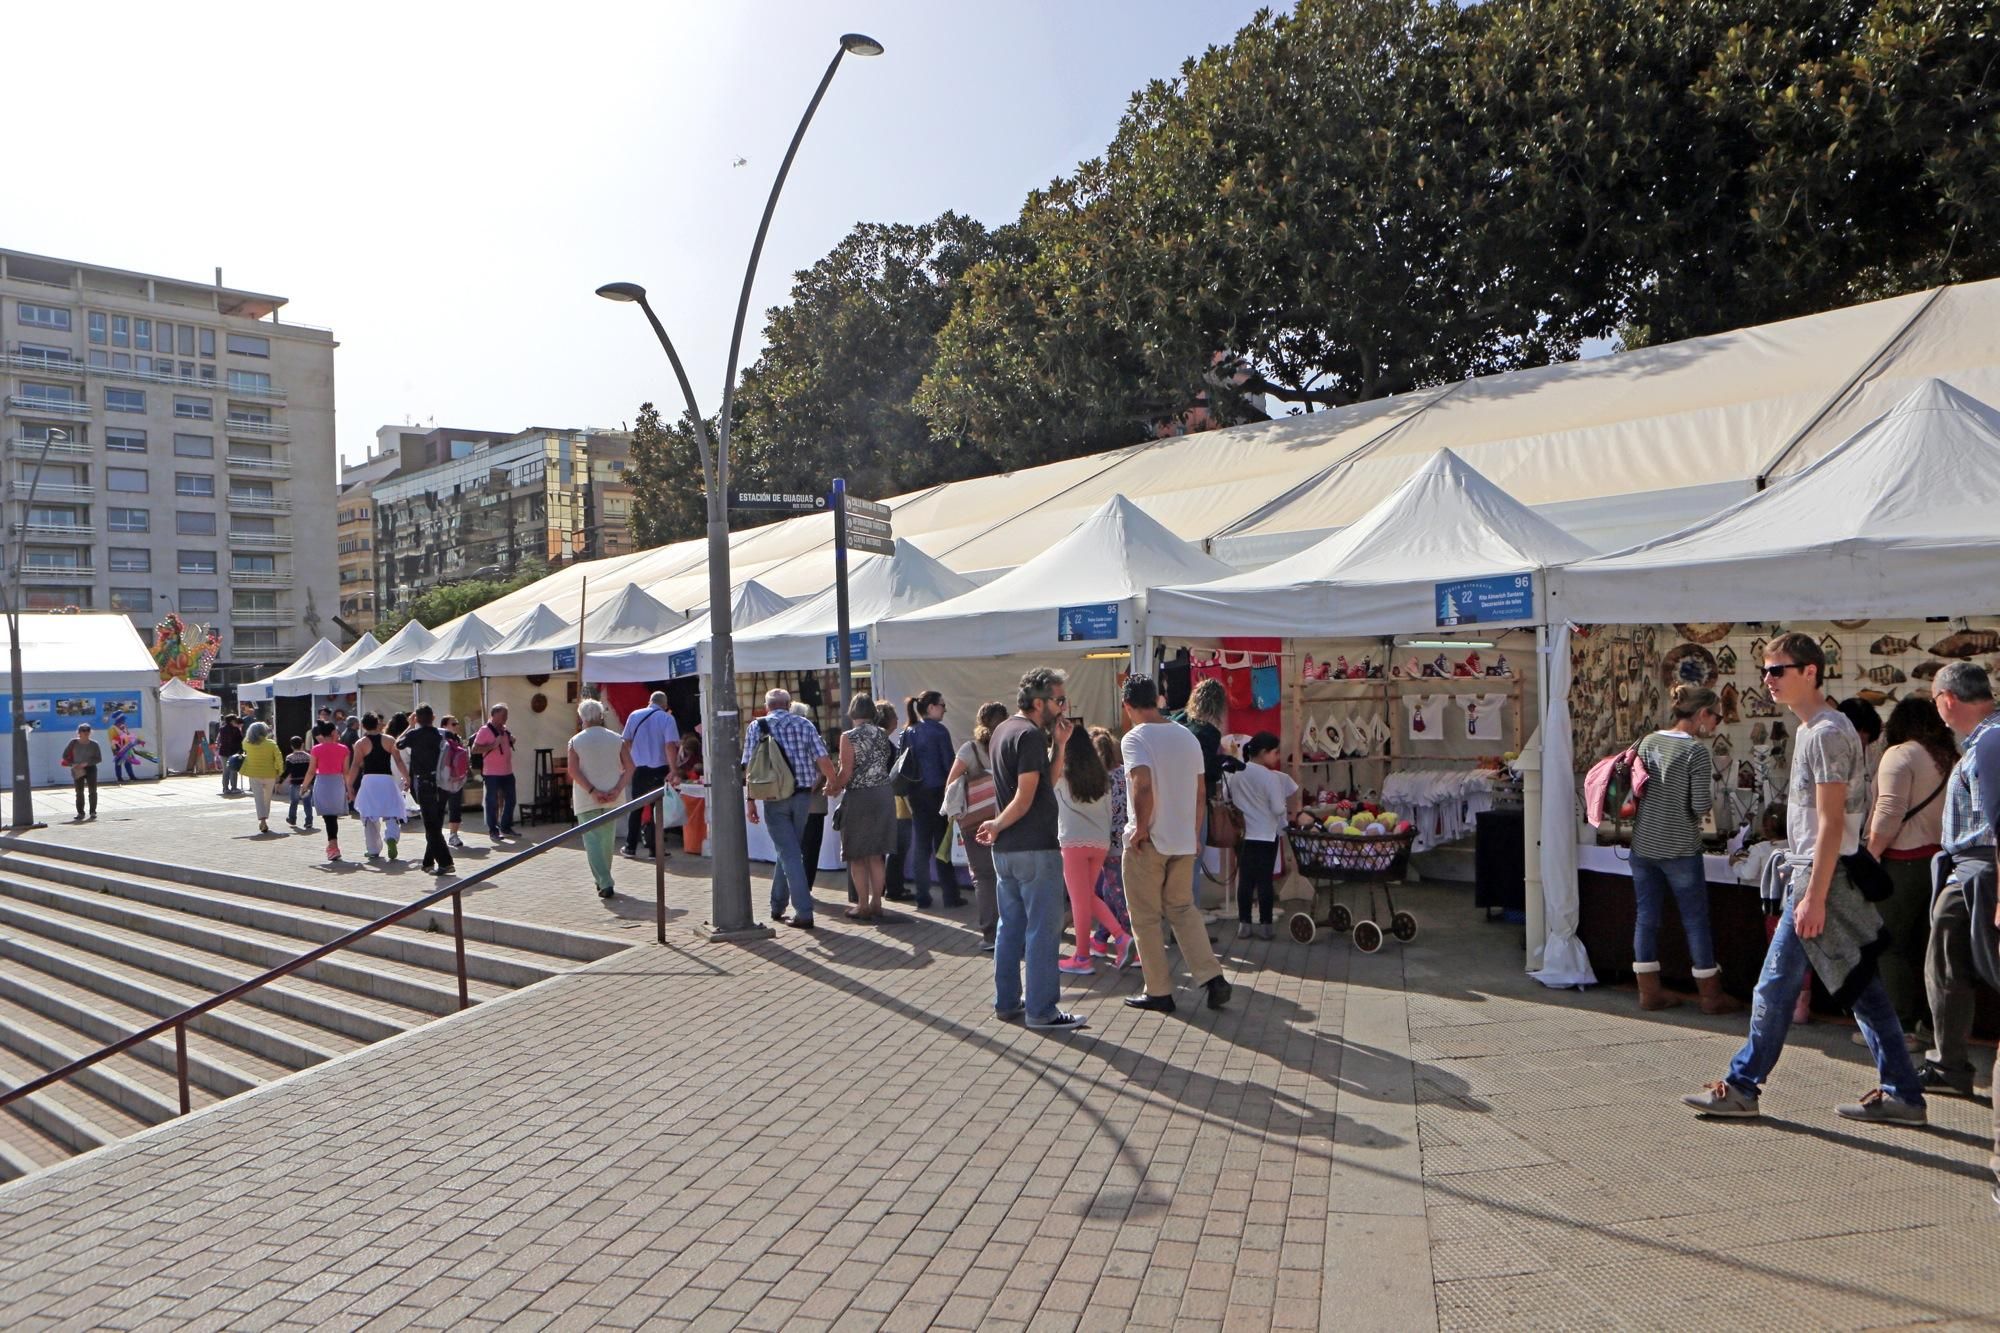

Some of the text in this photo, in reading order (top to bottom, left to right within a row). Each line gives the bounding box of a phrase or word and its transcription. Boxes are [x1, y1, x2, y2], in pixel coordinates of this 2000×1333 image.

[739, 492, 813, 503] ESTACIÓN DE GUAGUAS
[1514, 576, 1529, 588] 96
[1461, 590, 1473, 604] 22
[1107, 605, 1117, 614] 95
[1074, 614, 1082, 625] 22
